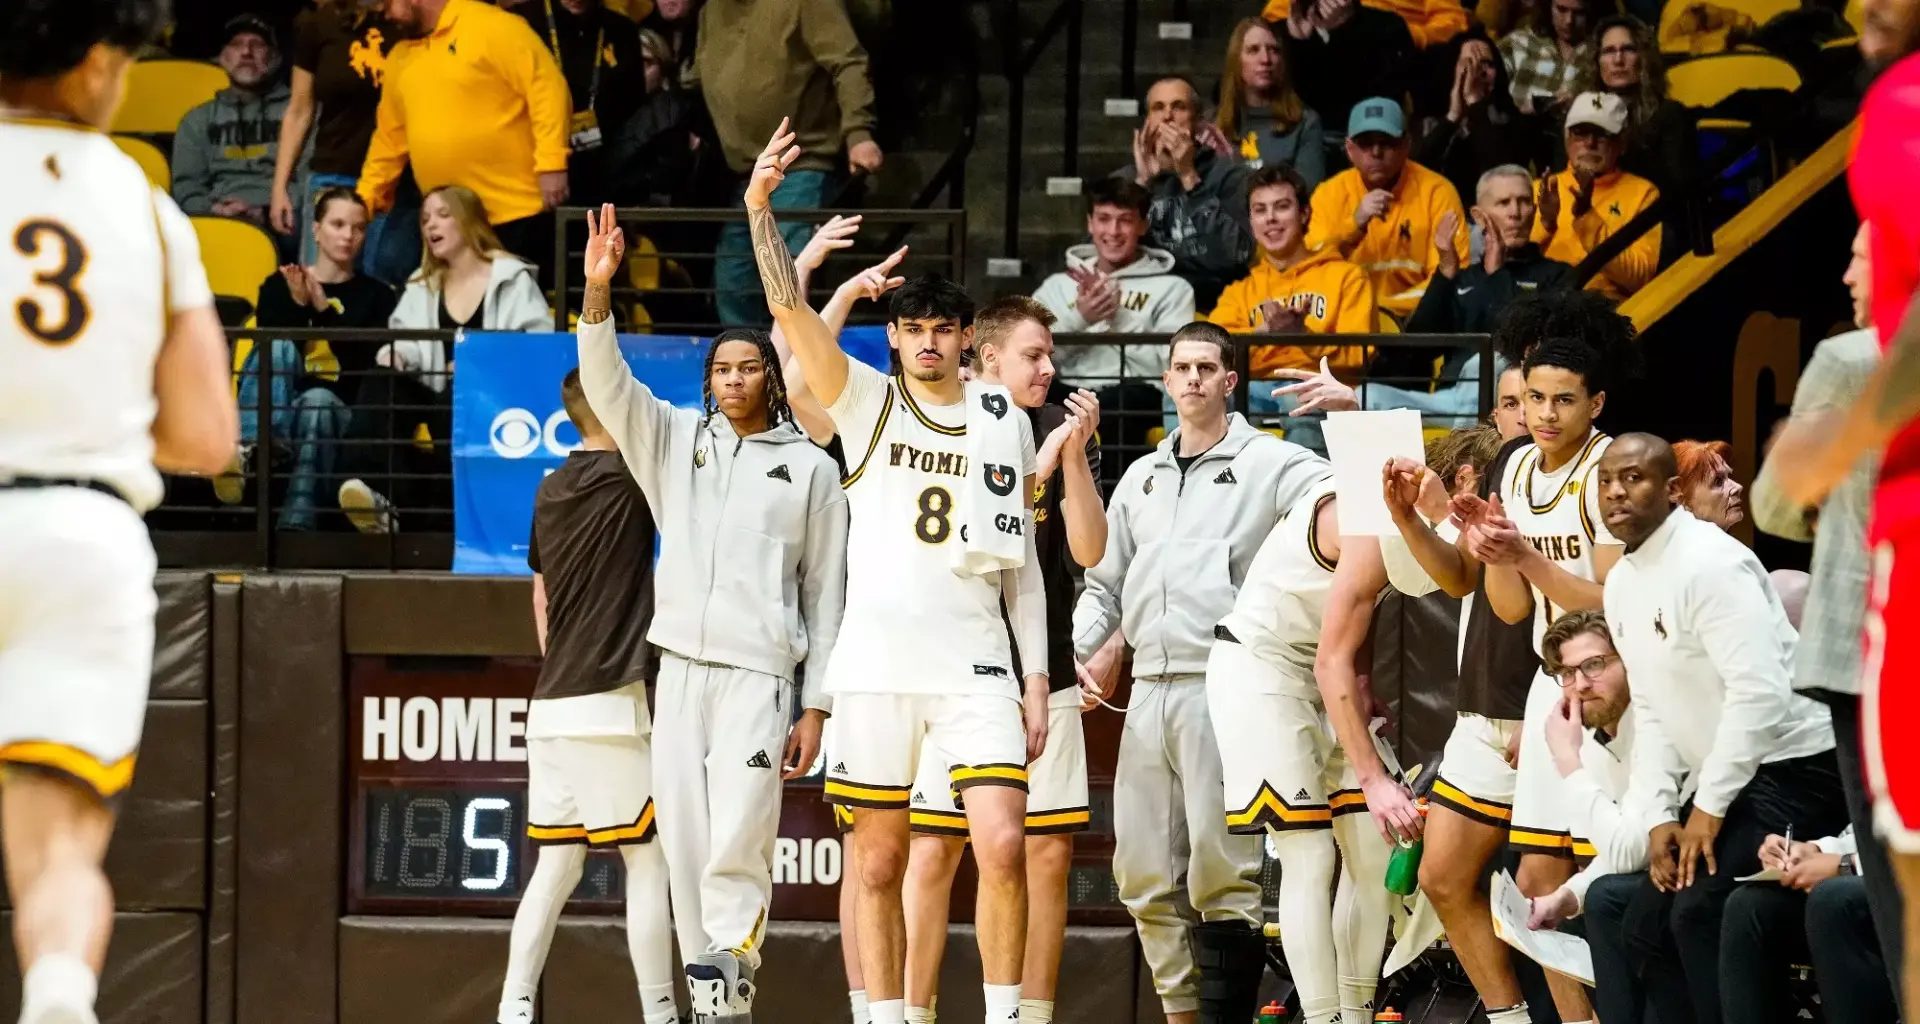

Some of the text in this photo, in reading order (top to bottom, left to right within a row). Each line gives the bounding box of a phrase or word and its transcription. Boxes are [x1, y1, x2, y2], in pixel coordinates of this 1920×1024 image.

[11, 218, 92, 348] 3
[543, 409, 583, 457] C
[889, 442, 968, 478] WYOMI
[913, 485, 956, 545] 8
[994, 512, 1025, 536] GA
[1523, 535, 1581, 561] MING
[362, 696, 527, 763] HOME
[461, 798, 511, 890] 5
[771, 837, 842, 885] RIO
